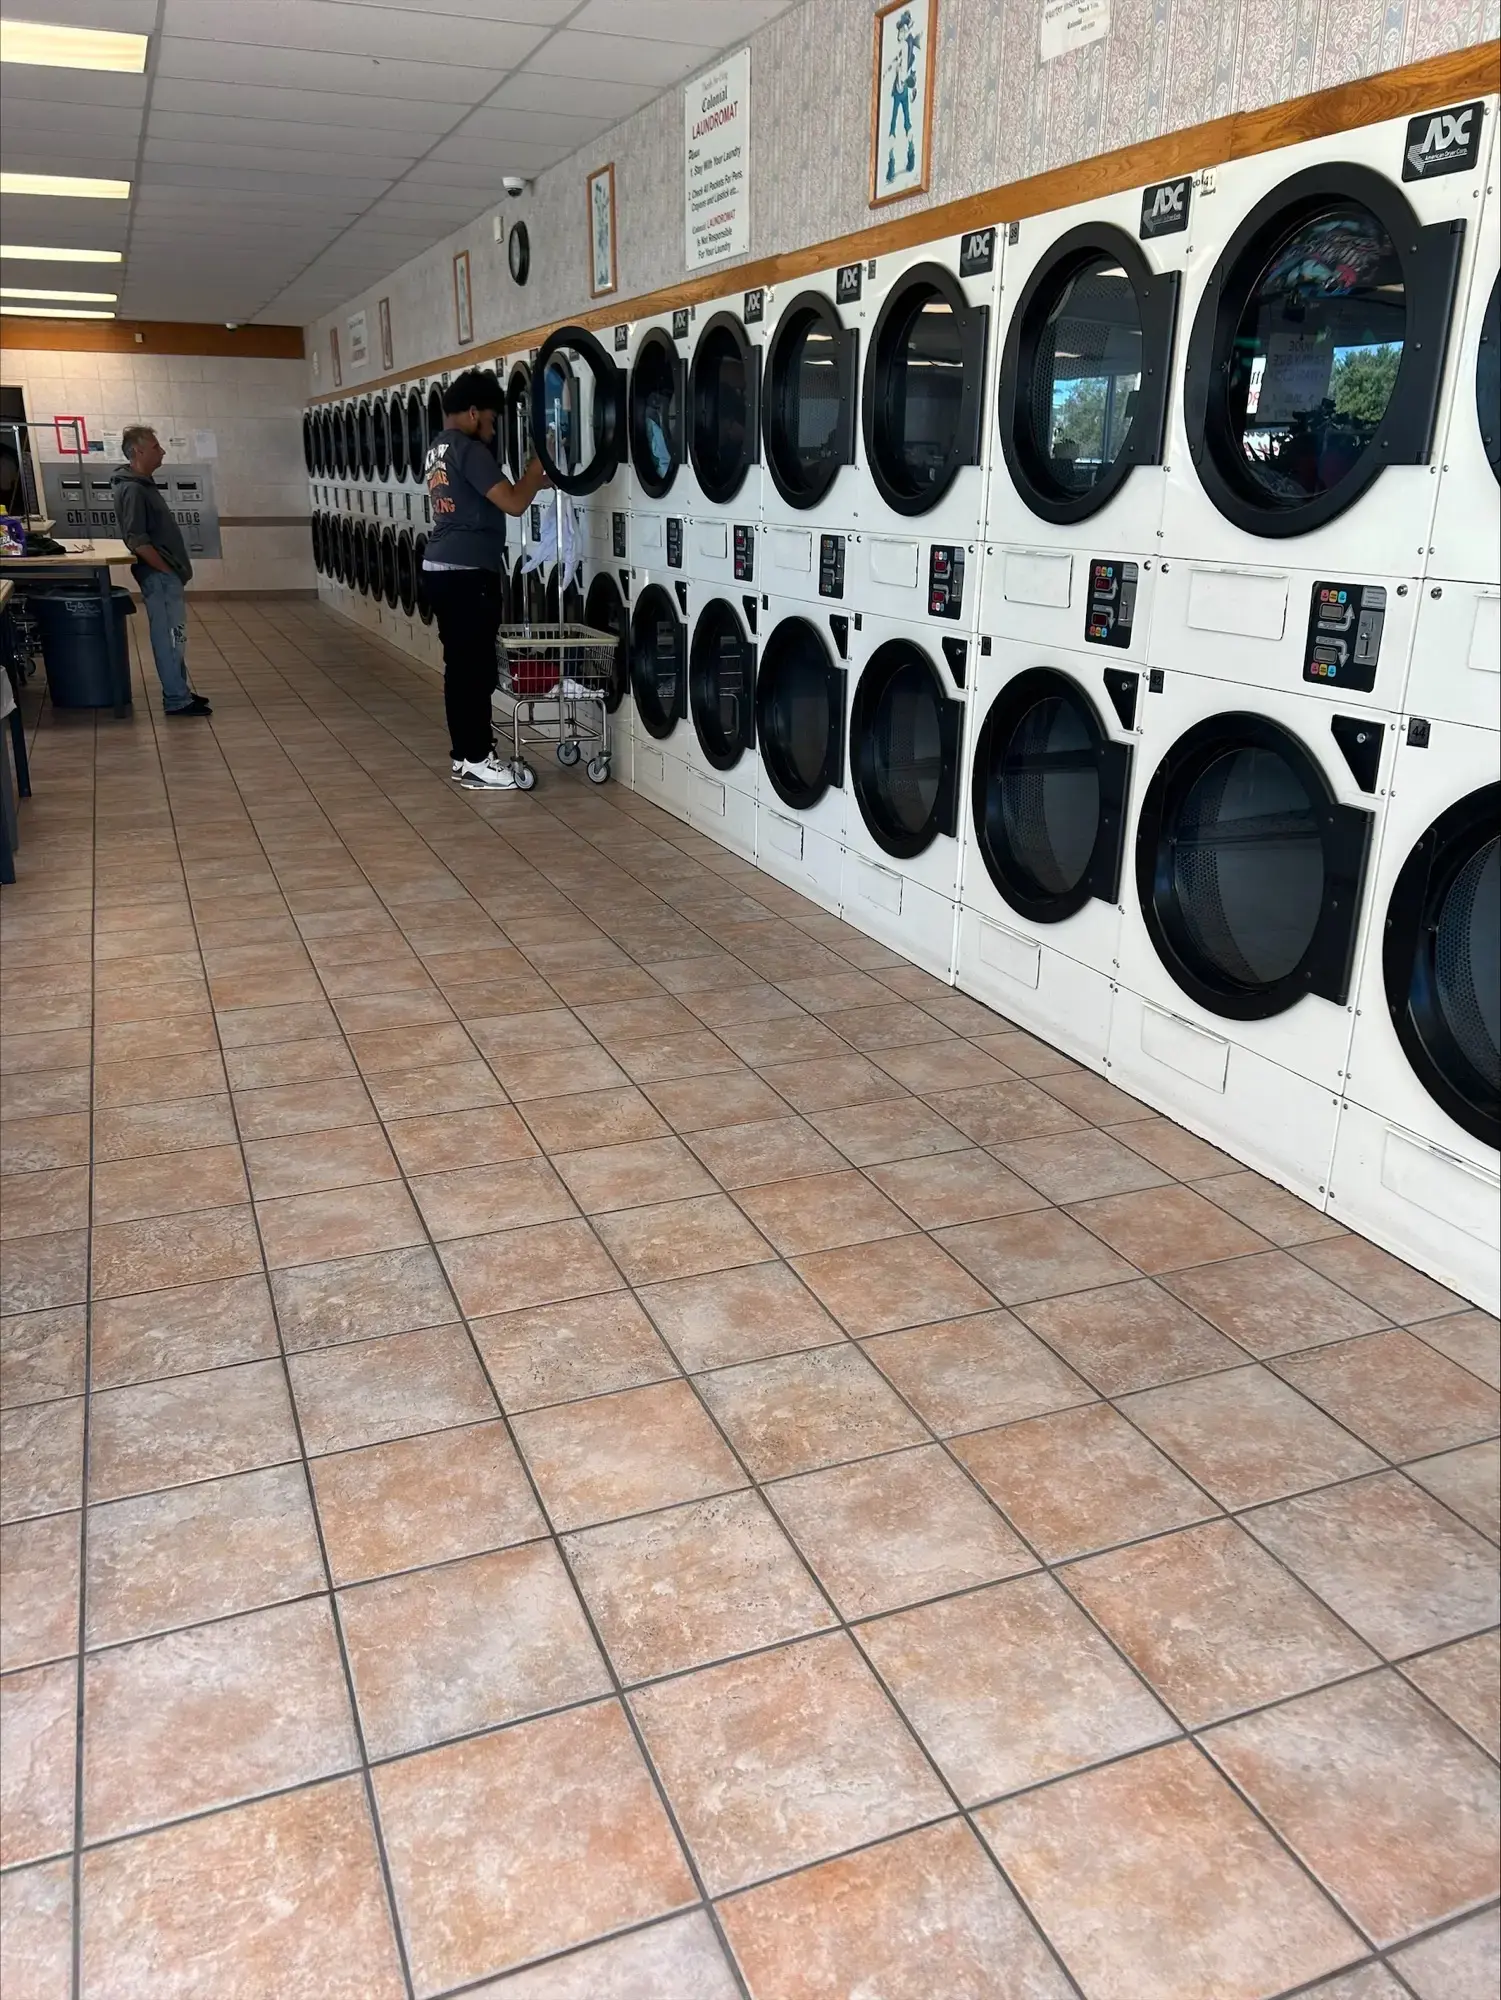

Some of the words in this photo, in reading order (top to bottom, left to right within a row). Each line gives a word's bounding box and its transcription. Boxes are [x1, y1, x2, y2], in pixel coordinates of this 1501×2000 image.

[702, 85, 728, 113] Colonial
[692, 101, 738, 140] LAUNDROMAT
[1420, 109, 1473, 154] ADC
[713, 155, 723, 166] Your
[723, 146, 741, 162] Laundry
[1151, 182, 1185, 217] ADC
[707, 208, 736, 229] LAUNDROMAT
[709, 226, 732, 243] Responsible
[967, 231, 990, 260] ADC
[715, 242, 731, 255] Laundry
[1411, 725, 1427, 737] 44
